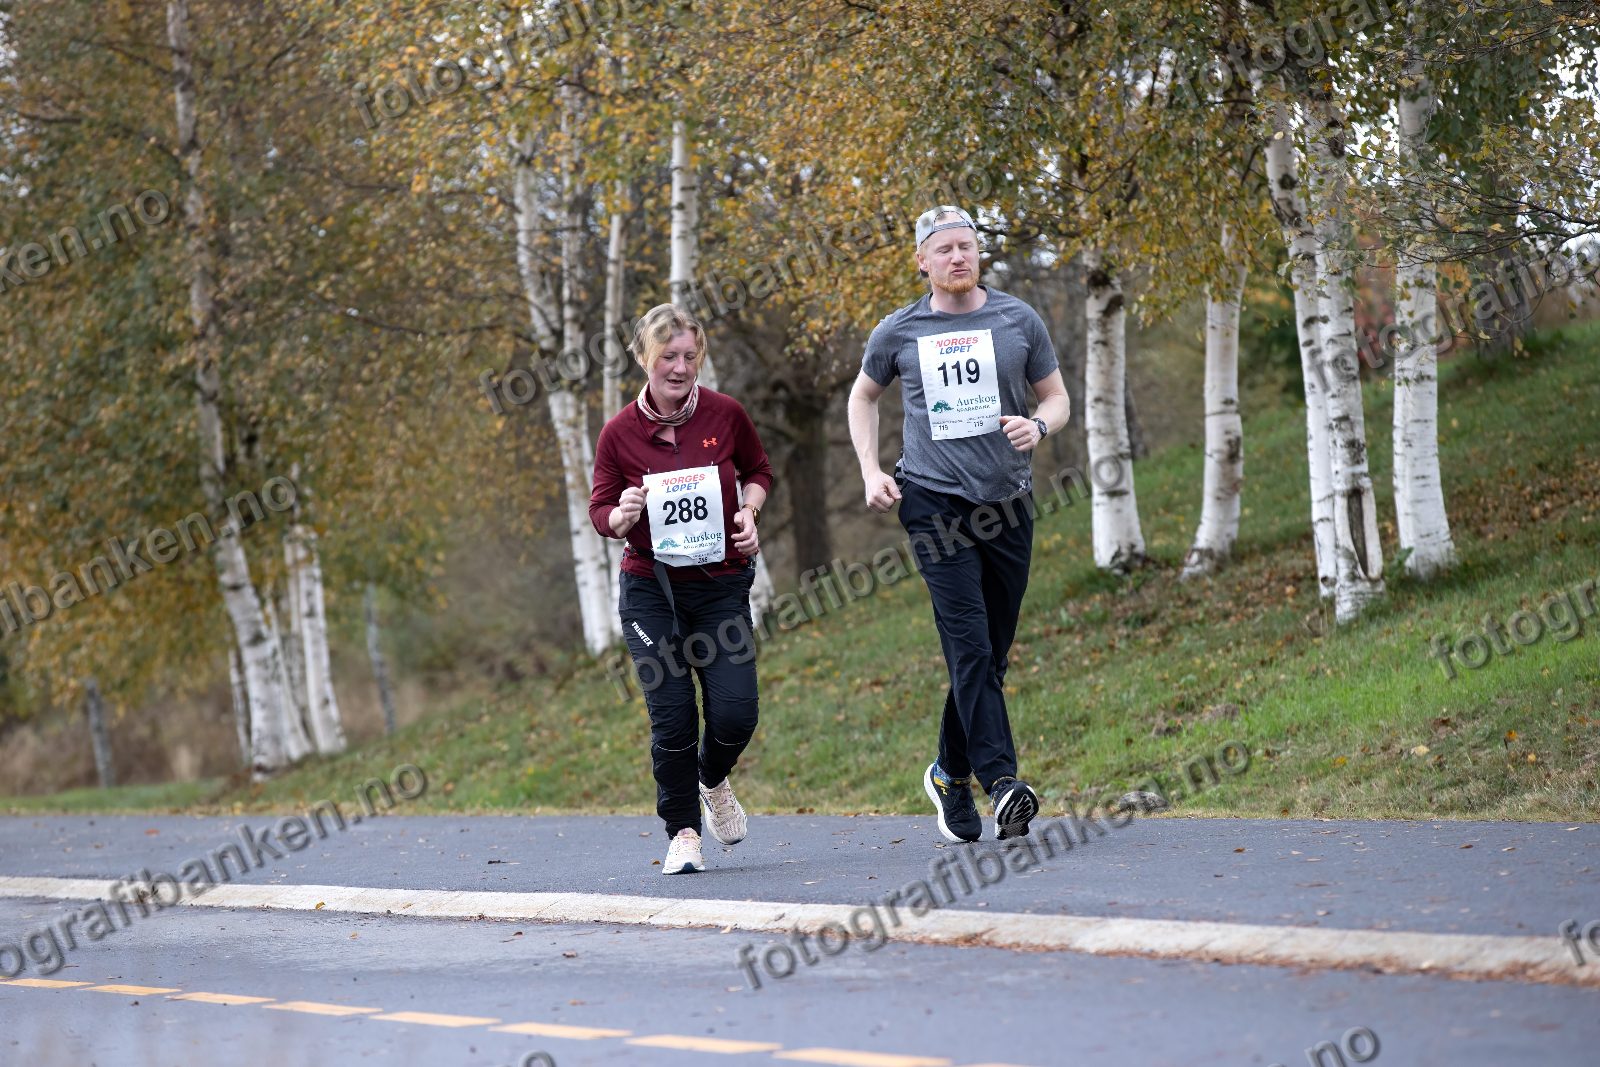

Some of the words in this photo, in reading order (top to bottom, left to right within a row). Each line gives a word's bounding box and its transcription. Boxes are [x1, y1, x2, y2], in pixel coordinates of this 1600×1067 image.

[936, 336, 979, 348] NORGES
[940, 344, 972, 355] LØPET
[937, 358, 981, 387] 119
[956, 395, 997, 406] Aurskog
[662, 473, 705, 486] NORGES
[666, 481, 700, 494] LØPET
[662, 495, 708, 526] 288
[683, 532, 723, 544] Aurskog
[631, 621, 654, 647] TRIMTEX
